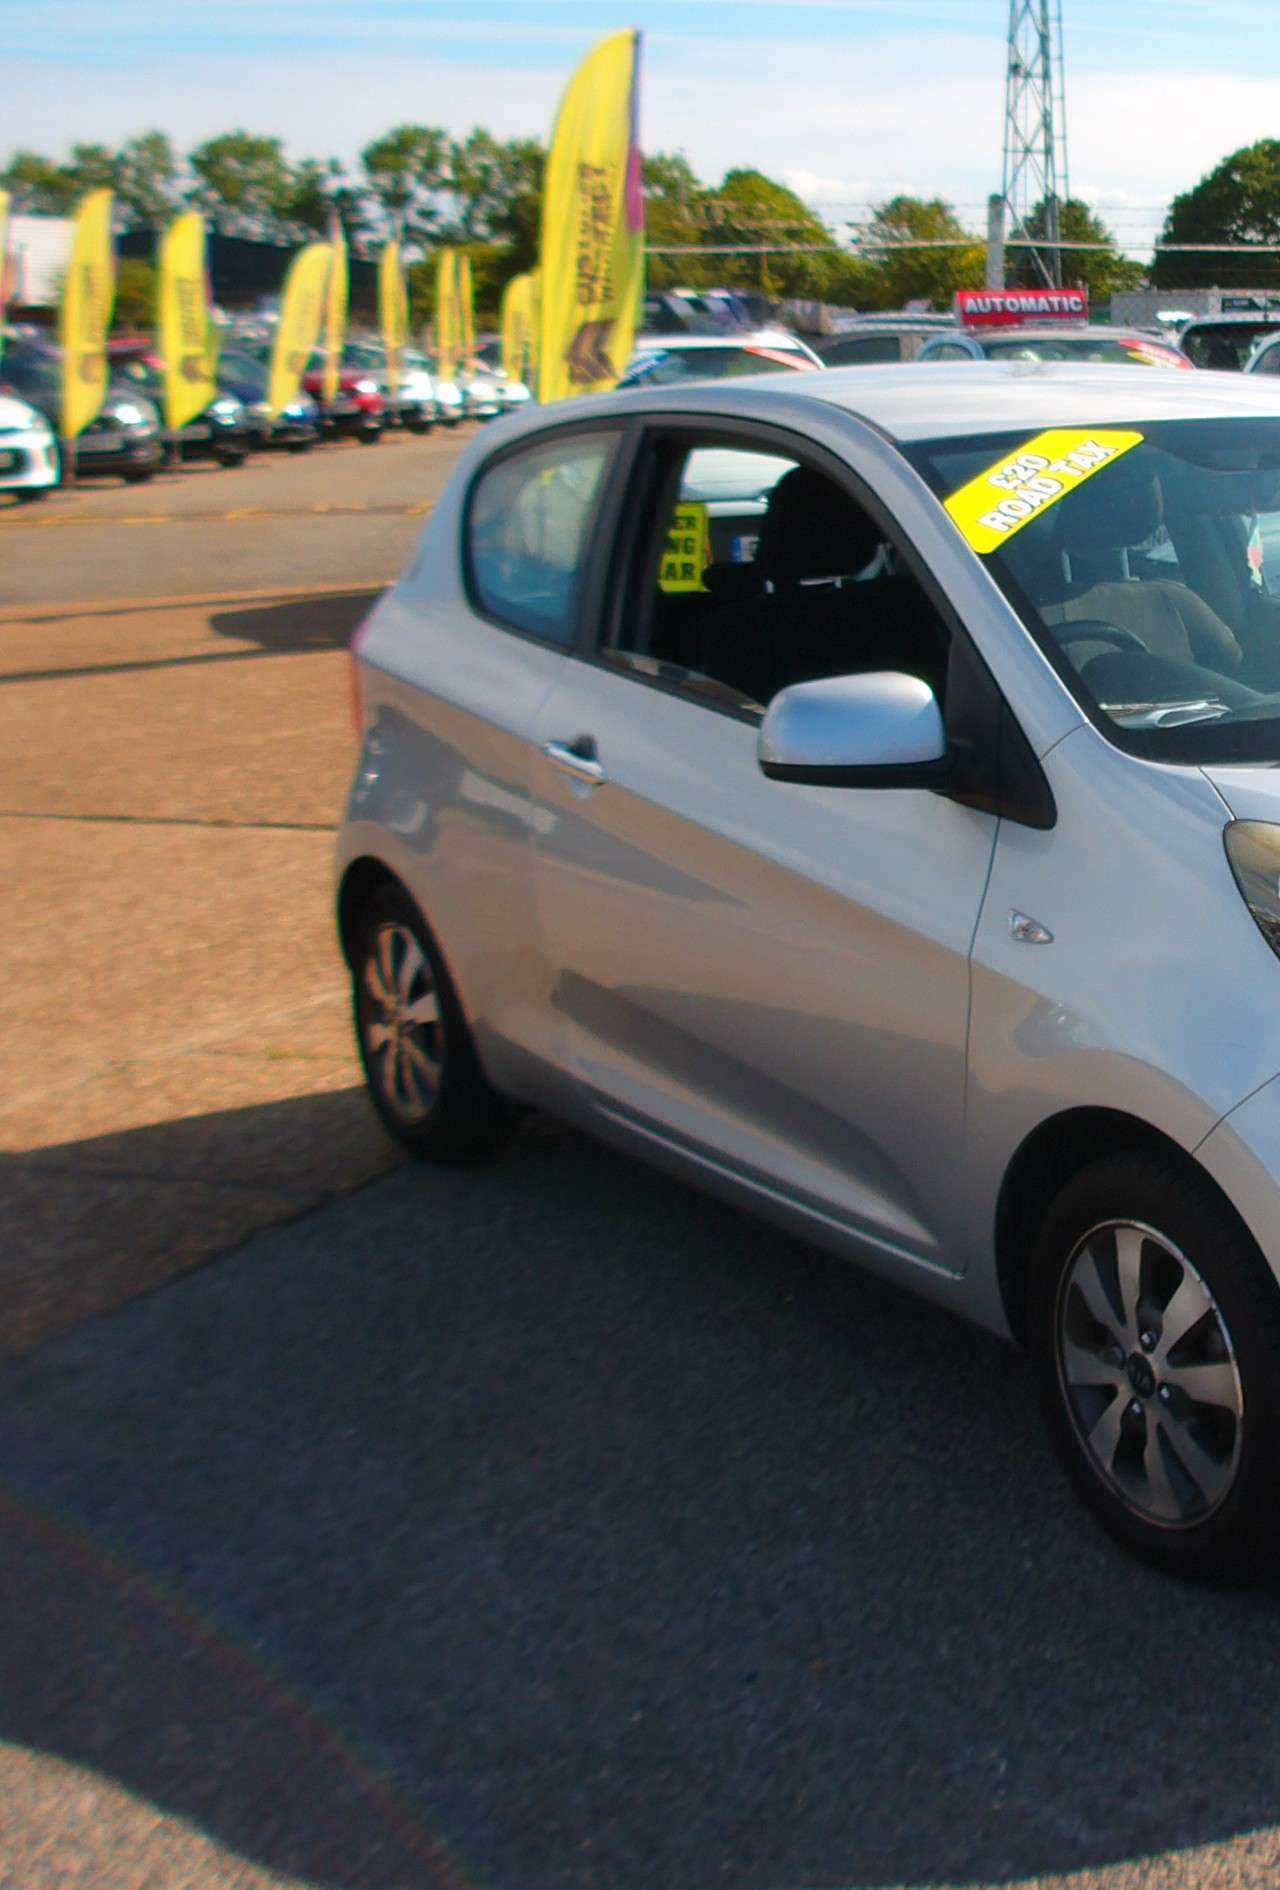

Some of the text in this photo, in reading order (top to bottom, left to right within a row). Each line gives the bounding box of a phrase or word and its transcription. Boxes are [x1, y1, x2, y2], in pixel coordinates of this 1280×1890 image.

[965, 297, 1083, 313] AUTOMATIC
[976, 440, 1118, 532] ROAD TAX
[987, 454, 1051, 490] £20
